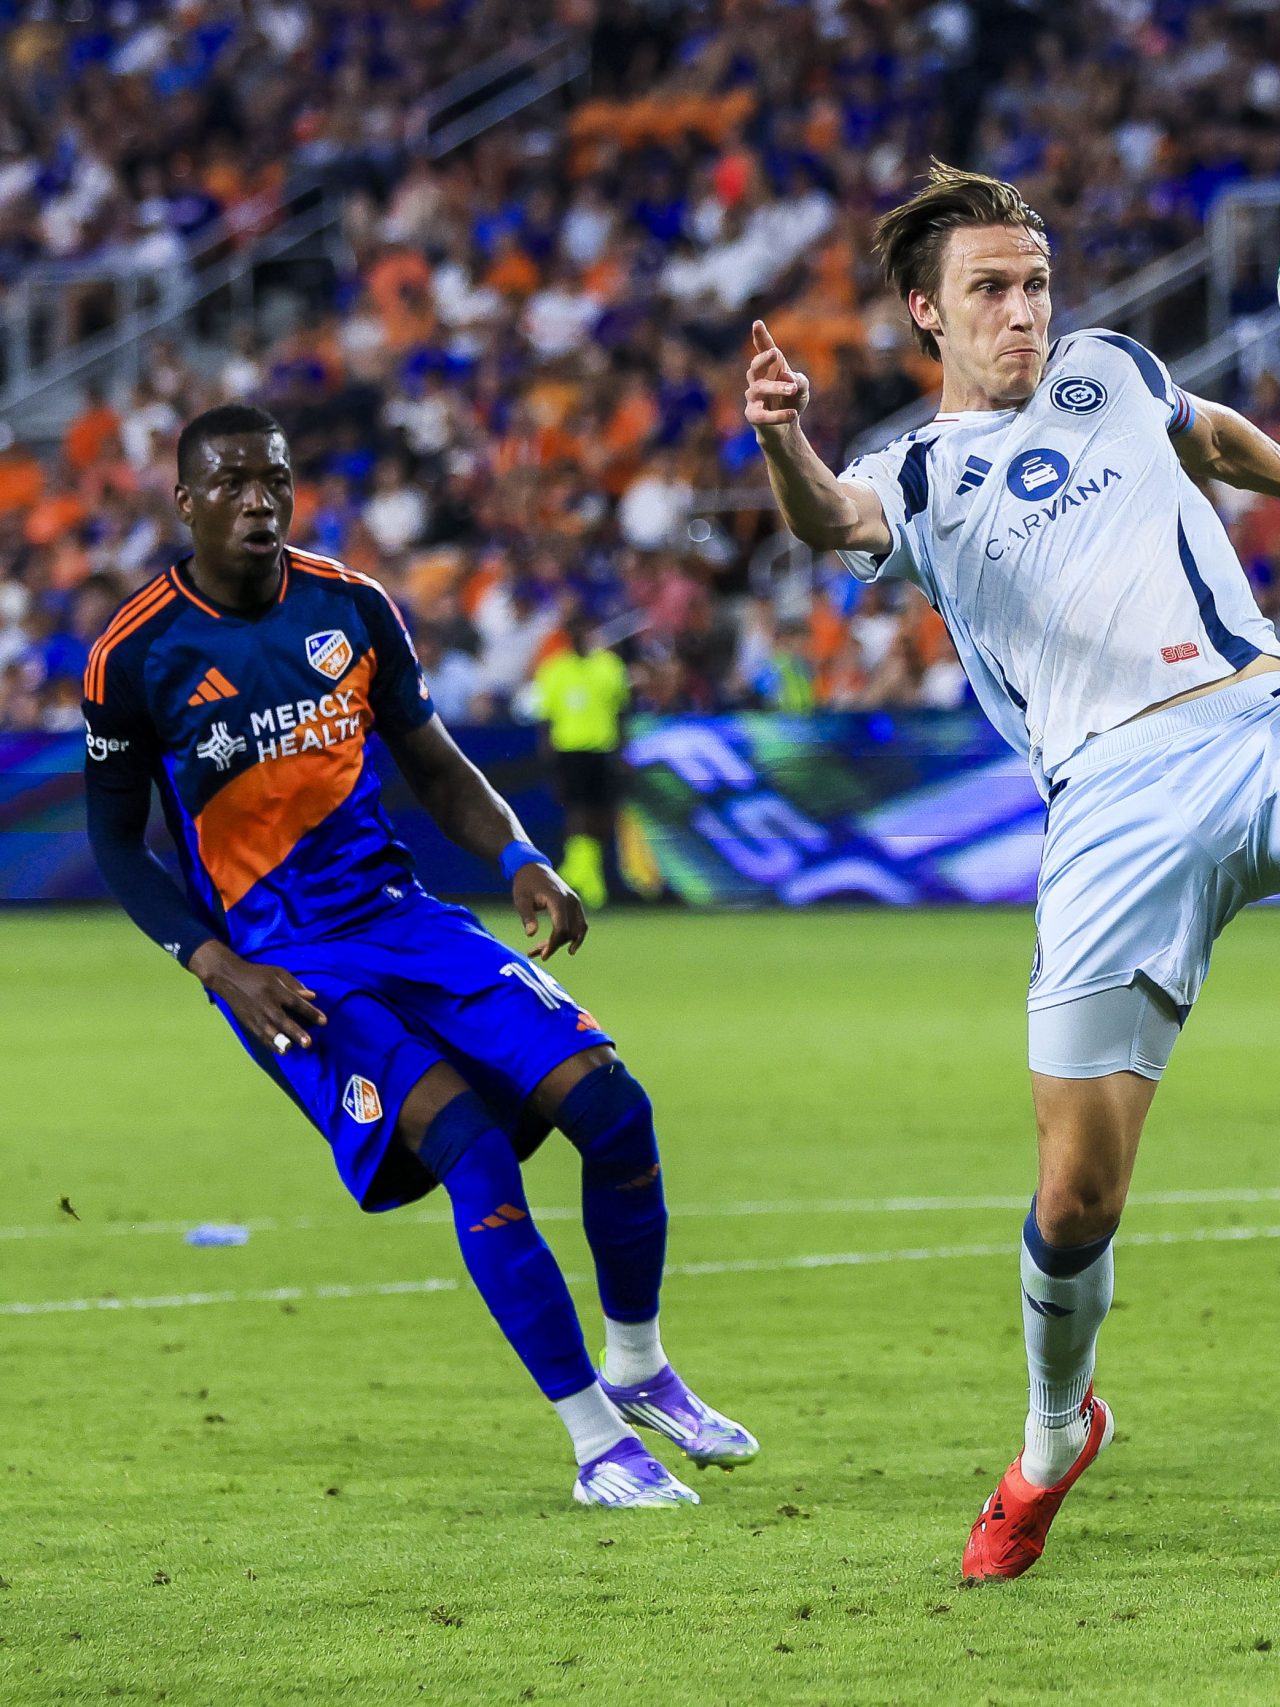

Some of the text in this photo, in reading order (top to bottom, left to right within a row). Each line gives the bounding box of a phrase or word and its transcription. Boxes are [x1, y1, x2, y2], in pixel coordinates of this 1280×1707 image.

[985, 467, 1122, 561] CARVANA
[1160, 641, 1200, 664] 312
[250, 688, 354, 738] MERCY
[256, 711, 361, 765] HEALTH
[85, 719, 130, 761] oger
